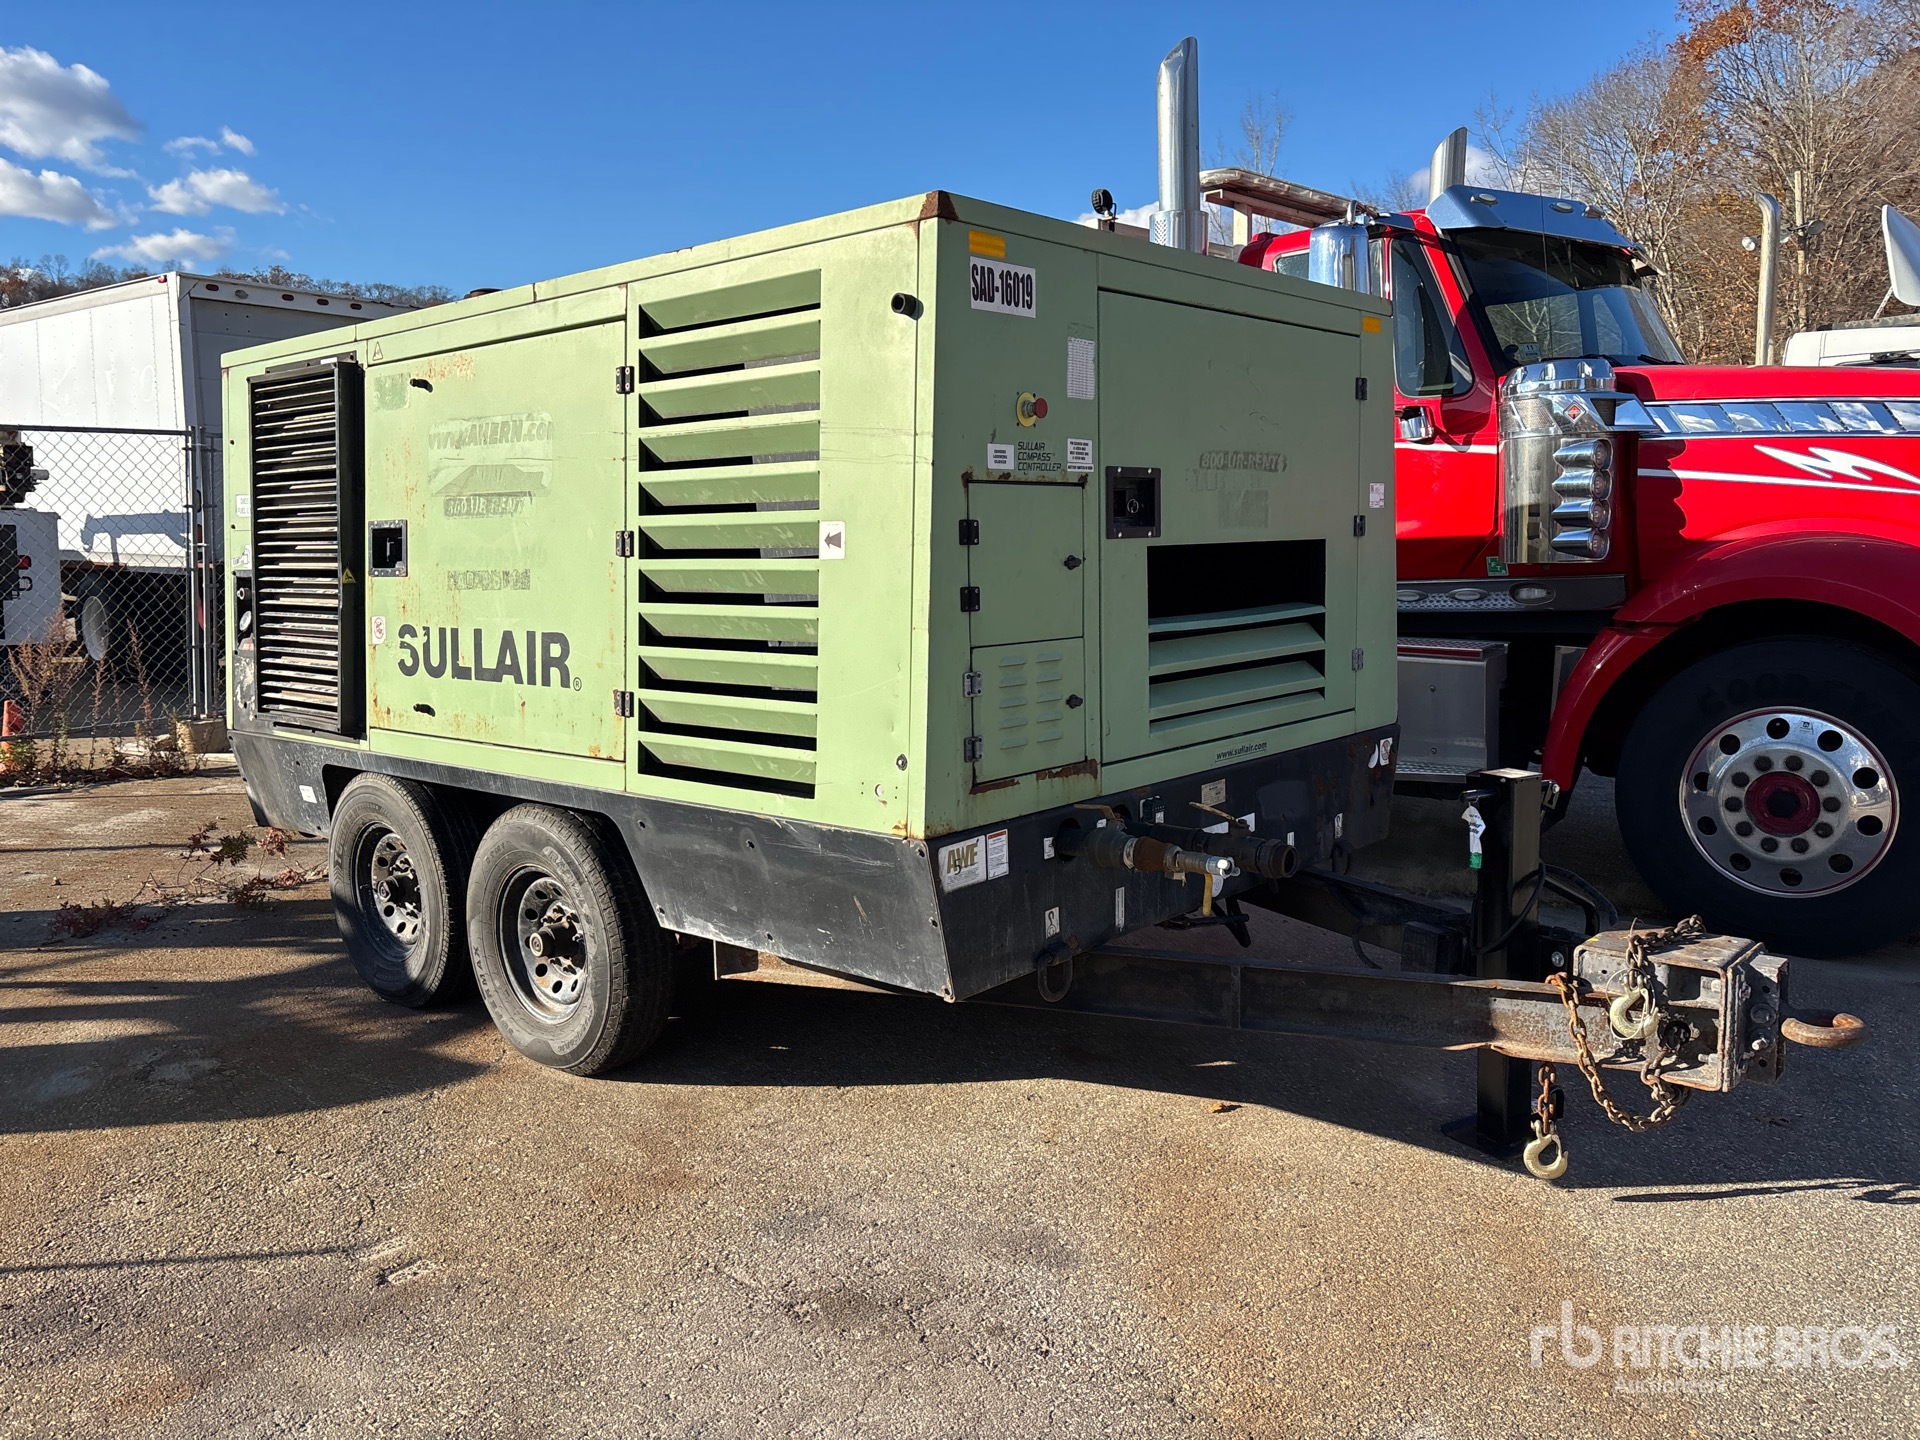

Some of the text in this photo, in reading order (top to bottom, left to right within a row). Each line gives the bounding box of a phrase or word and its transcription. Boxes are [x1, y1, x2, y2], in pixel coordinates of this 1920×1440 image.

[971, 263, 1033, 310] SAD-16019
[1017, 441, 1046, 451] SULLAIR
[1017, 462, 1062, 472] CONTROLLER
[1216, 742, 1267, 760] www.sullair.com
